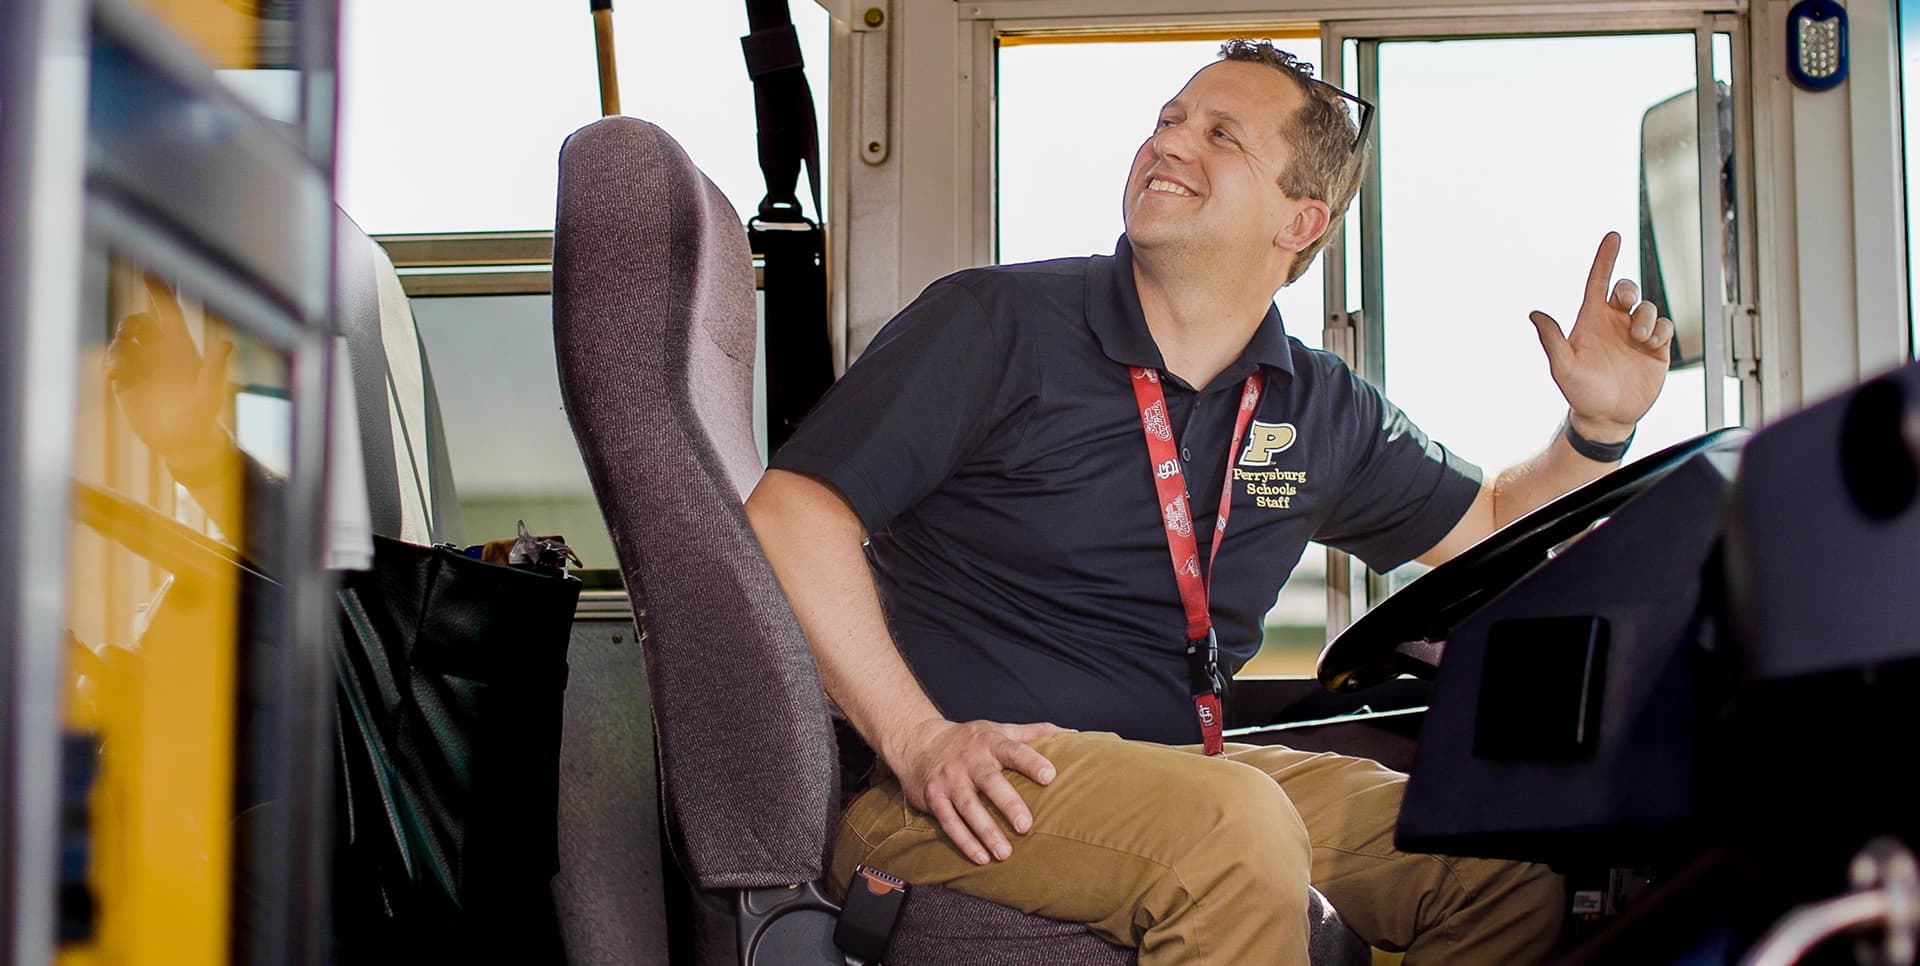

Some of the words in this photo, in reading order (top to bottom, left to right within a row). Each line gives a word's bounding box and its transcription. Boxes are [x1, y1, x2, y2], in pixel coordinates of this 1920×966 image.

[1239, 420, 1297, 466] P
[1232, 468, 1306, 483] Perrysburg
[1247, 483, 1297, 495] Schools
[1256, 496, 1290, 508] Staff
